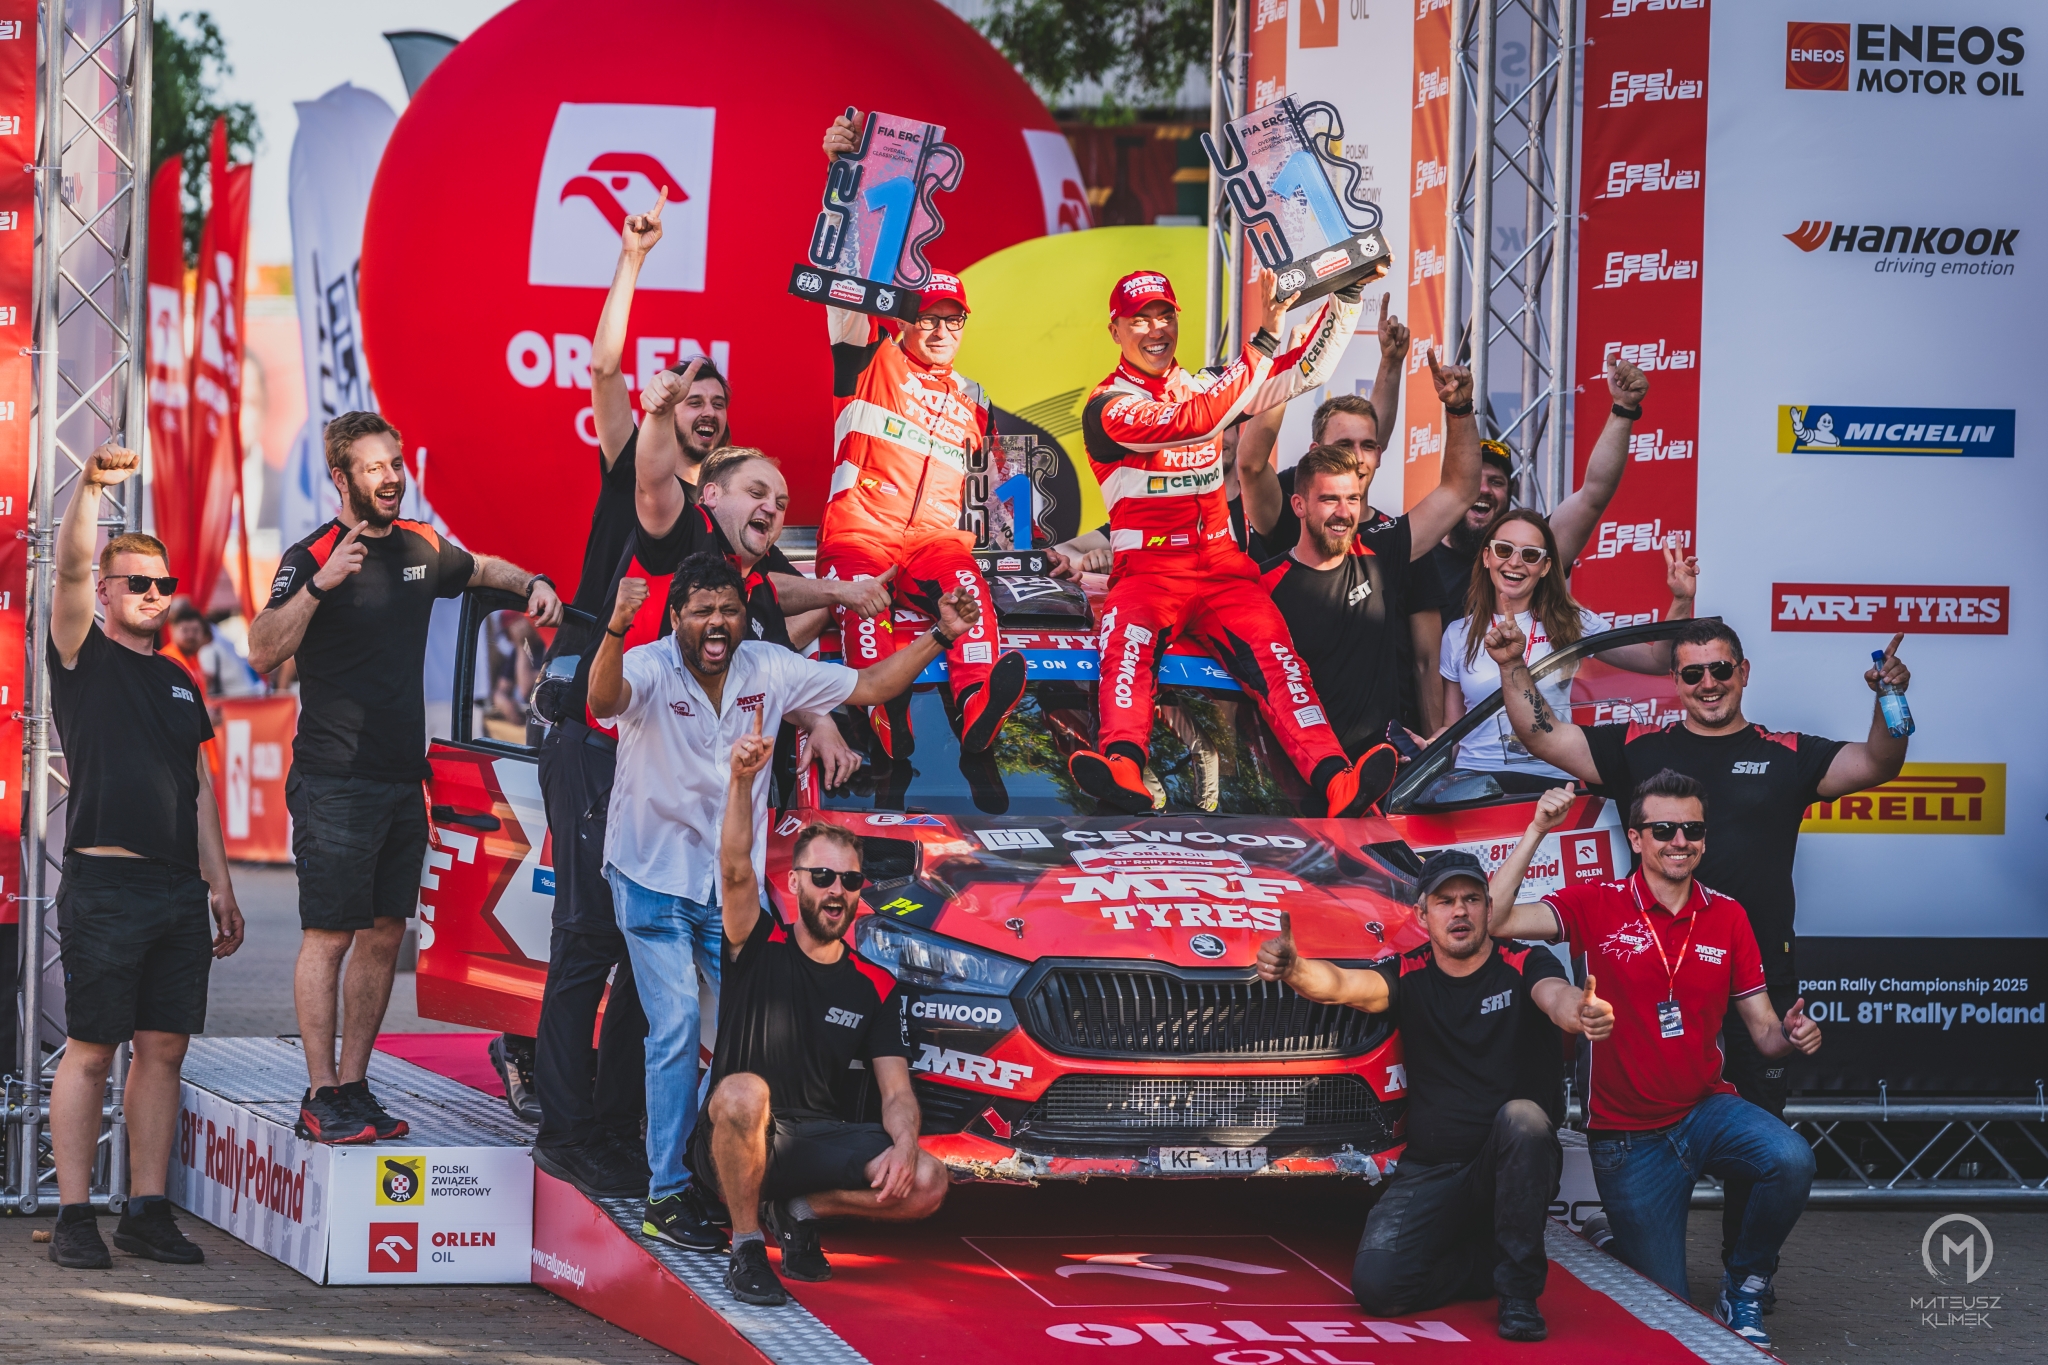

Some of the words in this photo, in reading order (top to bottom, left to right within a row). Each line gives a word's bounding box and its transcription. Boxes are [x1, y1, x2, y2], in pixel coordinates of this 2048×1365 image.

[1857, 23, 2025, 66] ENEOS
[1790, 48, 1845, 63] ENEOS
[1611, 68, 1673, 89] Feel
[1856, 68, 1966, 95] MOTOR
[1977, 71, 2024, 96] OIL
[1597, 80, 1703, 109] gravel
[877, 126, 895, 139] FIA
[898, 129, 921, 143] ERC
[1241, 124, 1261, 138] FIA
[1262, 113, 1285, 130] ERC
[872, 150, 914, 164] CLASSIFICATION
[883, 146, 906, 156] OVERALL
[1345, 145, 1369, 159] POLSKI
[1608, 158, 1670, 180] Feel
[1593, 170, 1700, 199] gravel
[1271, 150, 1352, 247] 1
[862, 175, 917, 286] 1
[1606, 249, 1667, 270] Feel
[1874, 257, 1936, 277] driving
[1941, 259, 2014, 275] emotion
[1123, 275, 1166, 293] MRF
[1592, 260, 1698, 290] gravel
[1130, 284, 1165, 298] TYRES
[1604, 339, 1665, 360] Feel
[905, 400, 966, 446] TYRES
[1844, 423, 1996, 443] MICHELIN
[1163, 443, 1216, 467] TYRES
[995, 473, 1031, 550] 1
[1599, 519, 1661, 541] Feel
[403, 564, 427, 582] SRT
[1778, 594, 1887, 621] MRF
[1894, 596, 2001, 623] TYRES
[1042, 660, 1067, 669] ON
[171, 685, 195, 703] SRT
[737, 693, 765, 706] MRF
[1732, 761, 1770, 774] SRT
[1062, 830, 1307, 849] CEWOOD
[1490, 843, 1515, 861] 81st
[1525, 859, 1559, 879] and
[1575, 868, 1603, 878] ORLEN
[1058, 874, 1303, 903] MRF
[1099, 904, 1282, 931] TYRES
[1619, 934, 1645, 943] MRF
[1695, 944, 1727, 957] MRF
[1699, 954, 1721, 965] TYRES
[1798, 979, 1836, 995] pean
[1840, 979, 1876, 995] Rally
[1880, 978, 1990, 995] Championship
[1993, 979, 2028, 991] 2025
[1480, 989, 1513, 1014] SRT
[824, 1007, 864, 1029] SRT
[911, 1002, 1002, 1024] CEWOOD
[1809, 1001, 1850, 1022] OIL
[1857, 1002, 1893, 1023] 81st
[1896, 1002, 1958, 1030] Rally
[1961, 1002, 2045, 1023] Poland
[912, 1043, 1033, 1090] MRF
[1766, 1068, 1784, 1078] SRT
[181, 1108, 203, 1169] 81st
[205, 1119, 244, 1214] Rally
[245, 1139, 306, 1224] Poland
[432, 1166, 469, 1174] POLSKI
[431, 1177, 478, 1187] ZWIĄZEK
[390, 1192, 411, 1201] PZM
[431, 1188, 492, 1197] MOTOROWY
[431, 1232, 495, 1247] ORLEN
[431, 1251, 455, 1263] OIL
[532, 1248, 586, 1290] ww.rallypoland.pl
[1045, 1320, 1471, 1346] ORLEN
[1212, 1348, 1375, 1365] OIL
